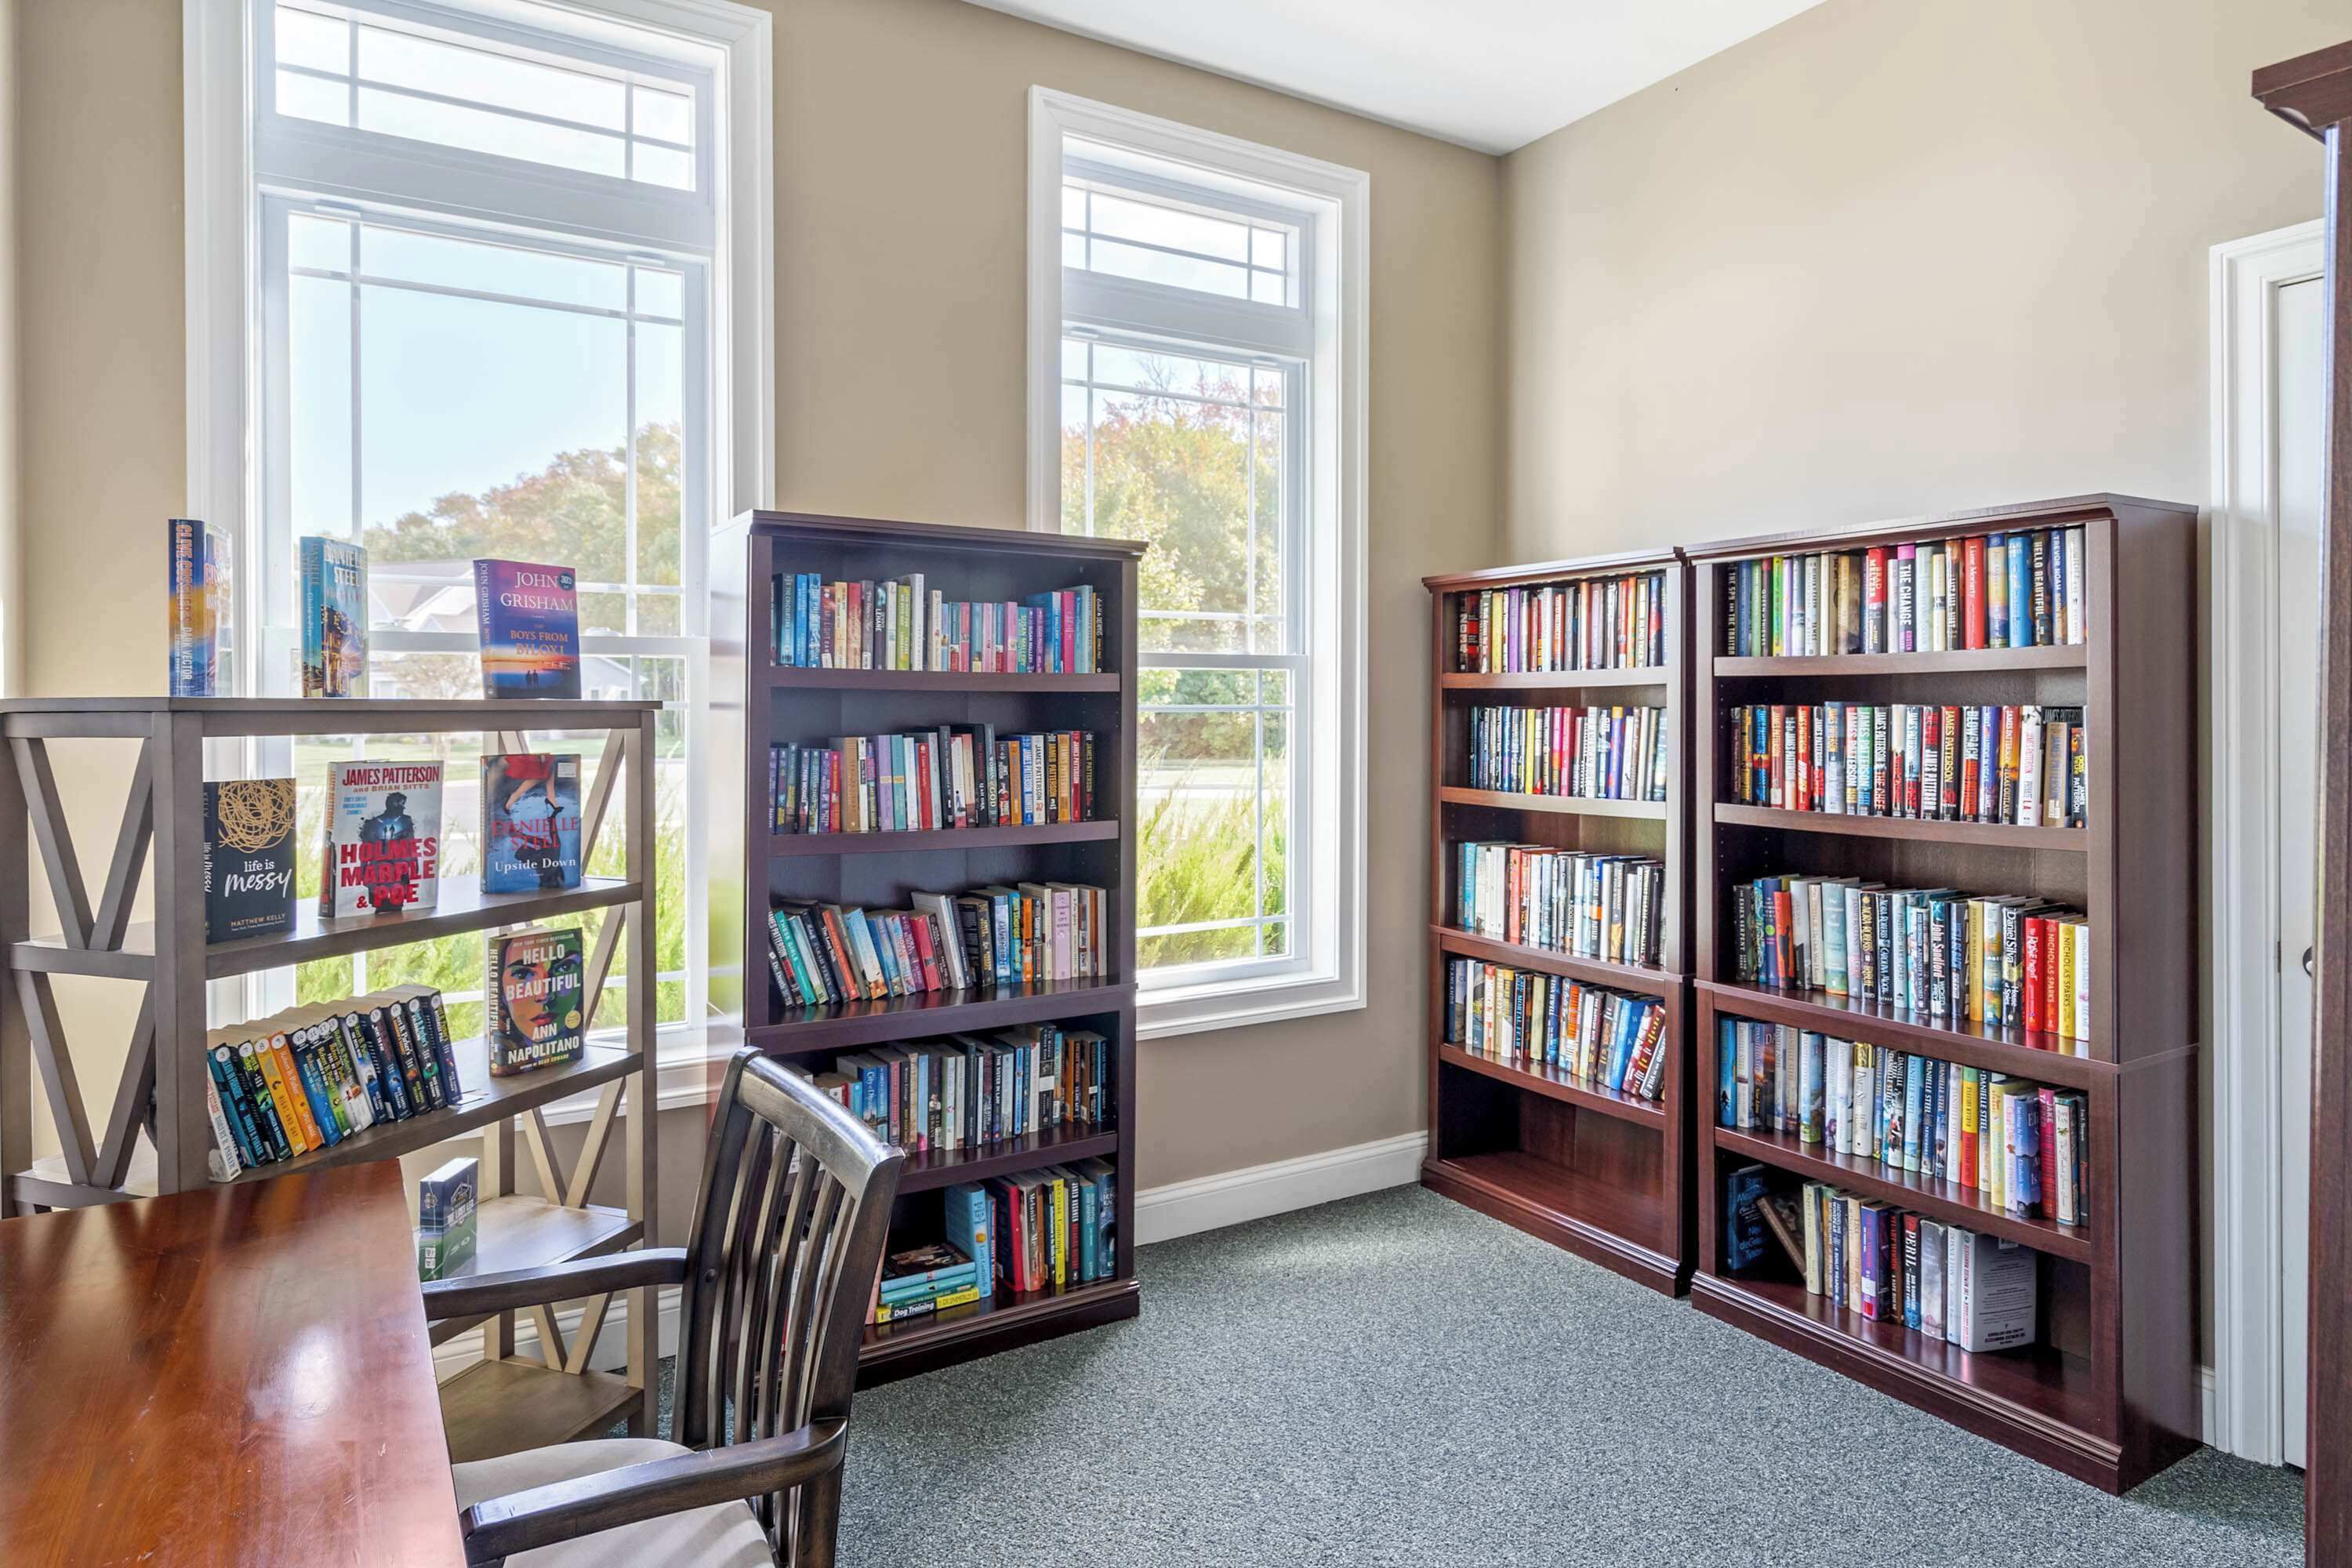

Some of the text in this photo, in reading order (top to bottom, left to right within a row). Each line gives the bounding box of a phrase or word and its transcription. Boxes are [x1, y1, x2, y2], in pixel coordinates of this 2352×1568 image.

[176, 524, 193, 561] CLIVE
[334, 568, 361, 586] STEEL
[479, 563, 488, 585] JOHN
[515, 572, 558, 588] JOHN
[2034, 541, 2044, 616] HELLO BEAUTIFUL
[501, 593, 574, 611] GRISHAM
[1900, 564, 1911, 626] THE CHANGE
[511, 630, 568, 641] BOYS FROM
[181, 626, 193, 680] DARK VECTOR
[517, 643, 564, 655] BILOXI
[1944, 710, 1955, 782] JAMES PATTERSON
[343, 765, 439, 786] JAMES PATTERSON
[492, 817, 578, 837] DANIELLE
[341, 837, 436, 864] HOLMES
[511, 834, 560, 851] STEEL
[245, 860, 274, 872] life is
[341, 859, 436, 887] MARPLE
[495, 858, 575, 873] Upside Down
[357, 884, 419, 908] & POE
[230, 916, 263, 927] MATTHEW
[1863, 906, 1872, 923] NORA
[2007, 911, 2016, 963] Daniel Silva
[523, 944, 564, 965] HELLO
[1932, 924, 1944, 978] John Sandford
[489, 949, 498, 1032] HELLO BEAUTIFUL
[506, 972, 580, 1001] BEAUTIFUL
[532, 1023, 557, 1040] ANN
[508, 1036, 579, 1064] NAPOLITANO
[1905, 1229, 1916, 1267] PERIL
[909, 1303, 934, 1314] Training
